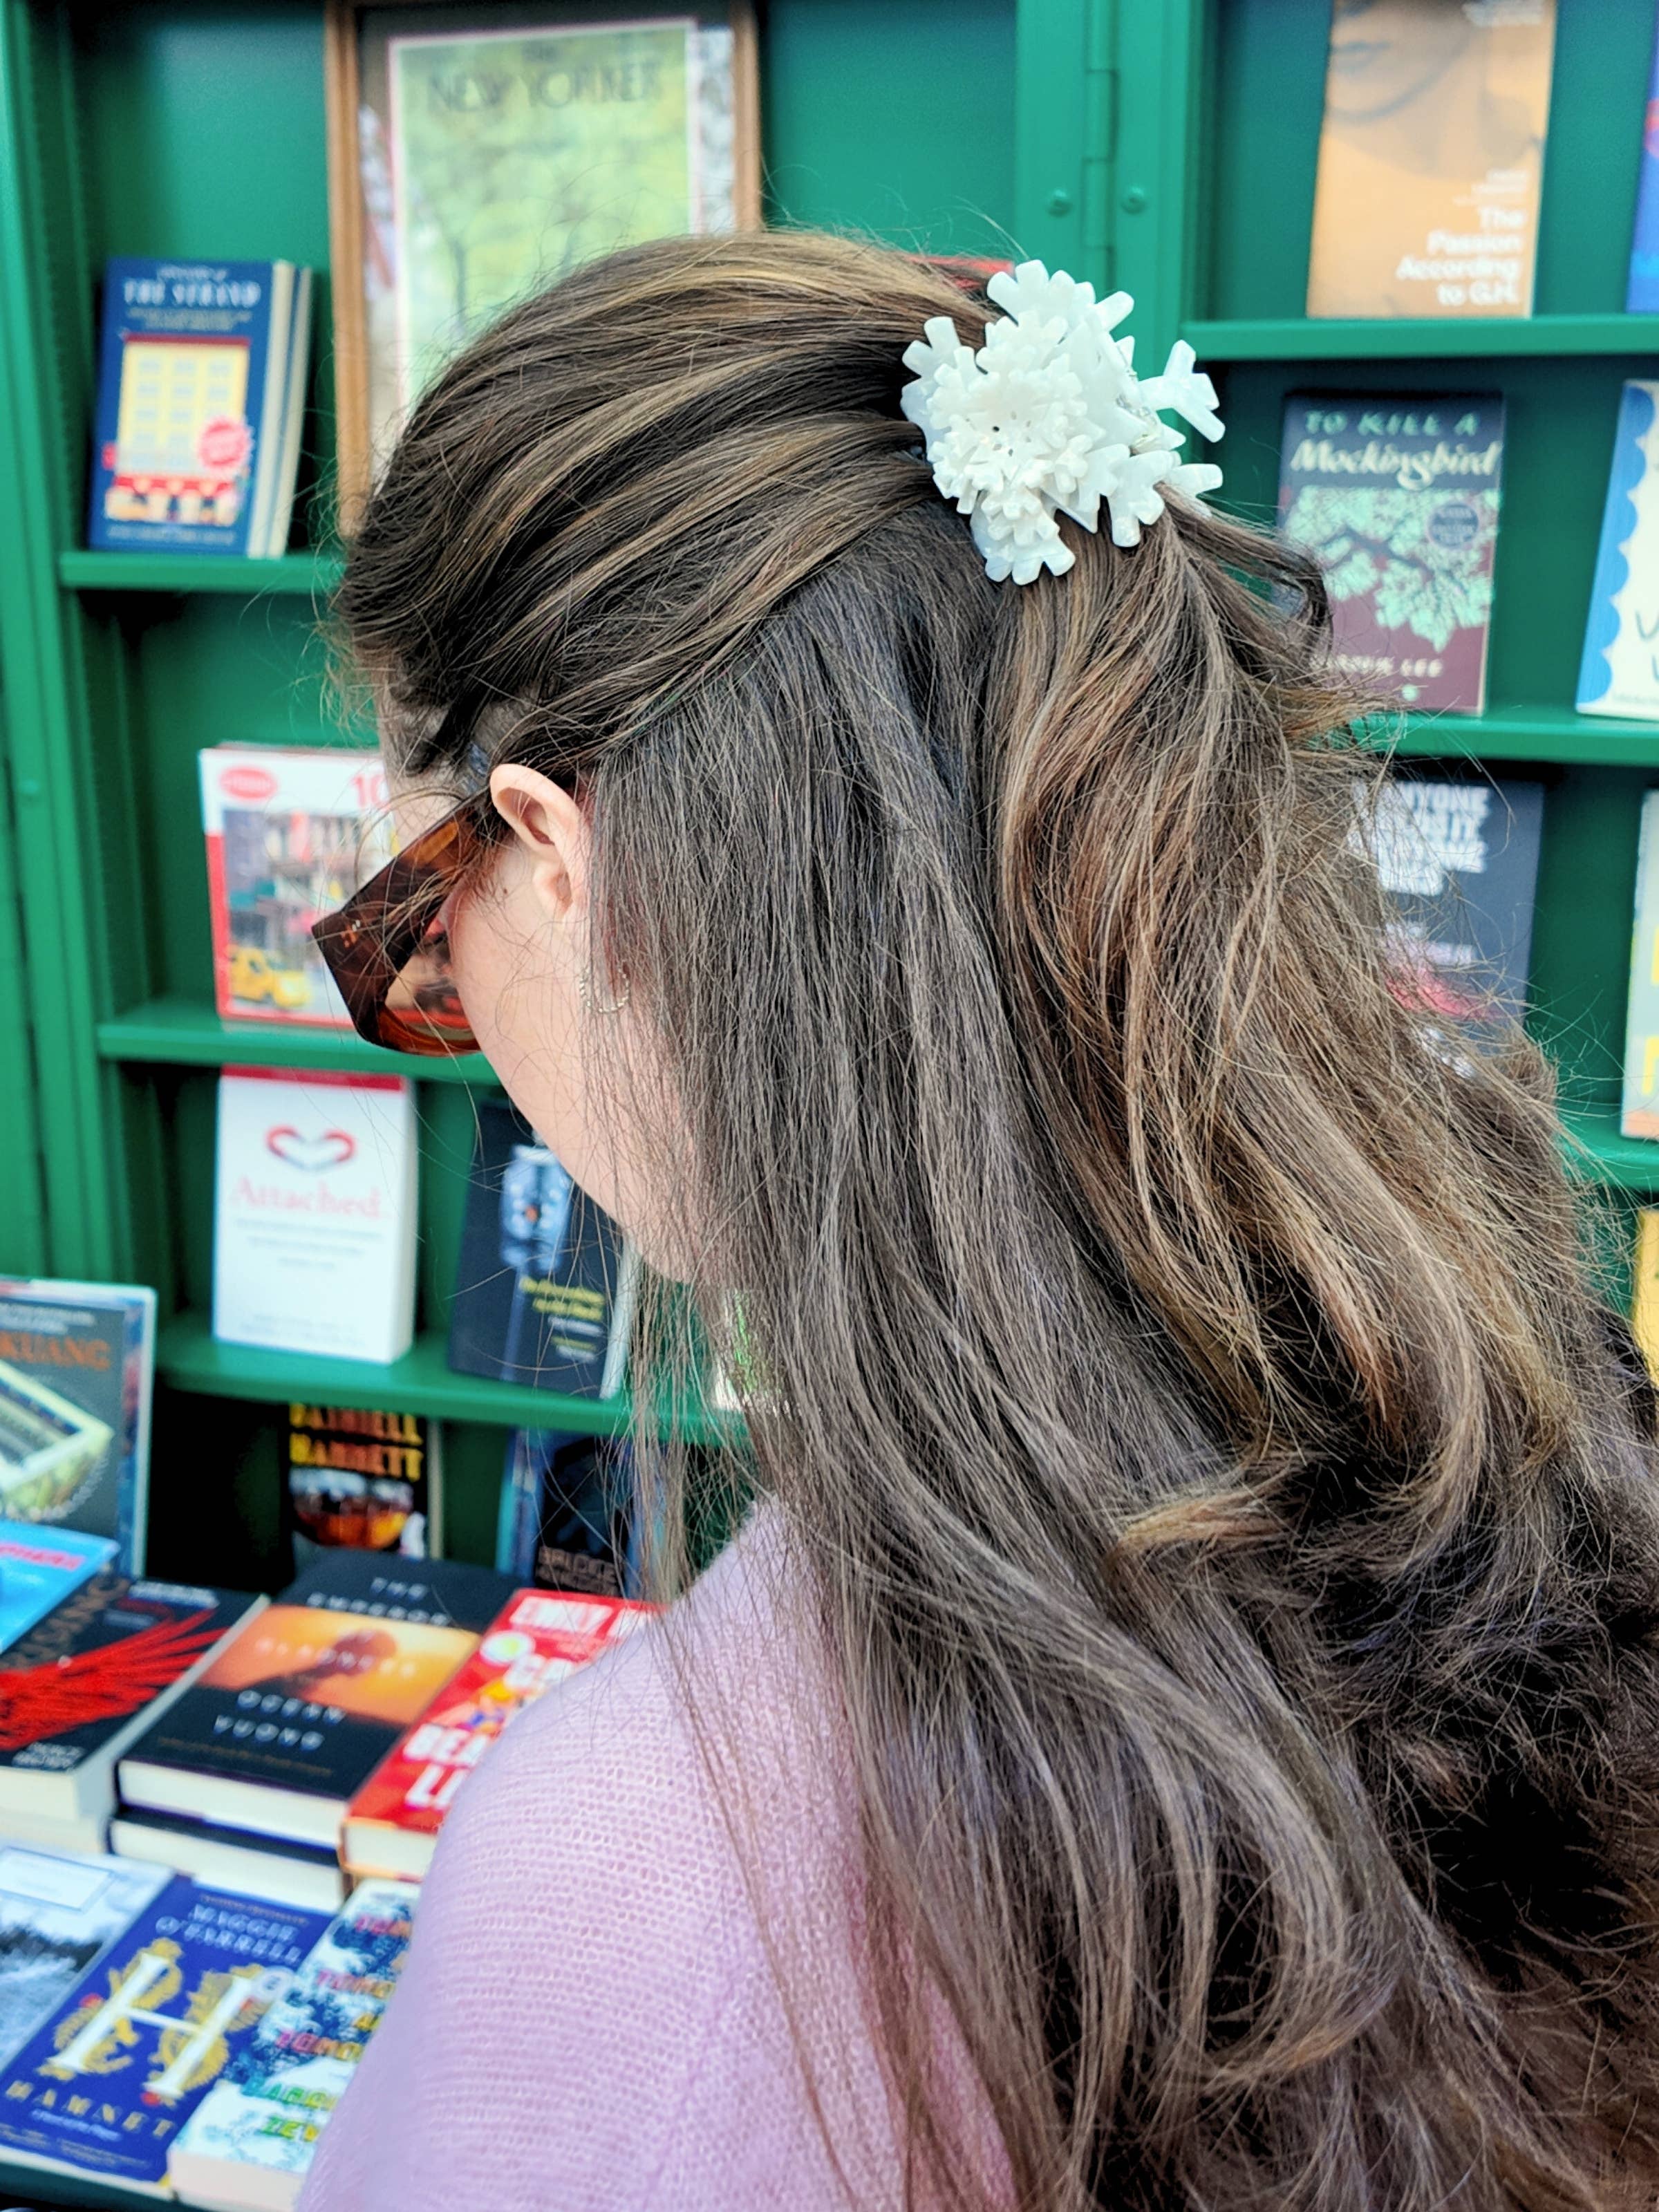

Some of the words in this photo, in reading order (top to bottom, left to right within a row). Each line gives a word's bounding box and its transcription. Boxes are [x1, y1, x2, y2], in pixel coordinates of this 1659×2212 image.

[1305, 411, 1347, 435] TO
[1357, 412, 1439, 436] KILL
[1454, 413, 1478, 436] A
[1290, 438, 1503, 491] Mockingbird
[236, 1689, 346, 1725] OCEAN
